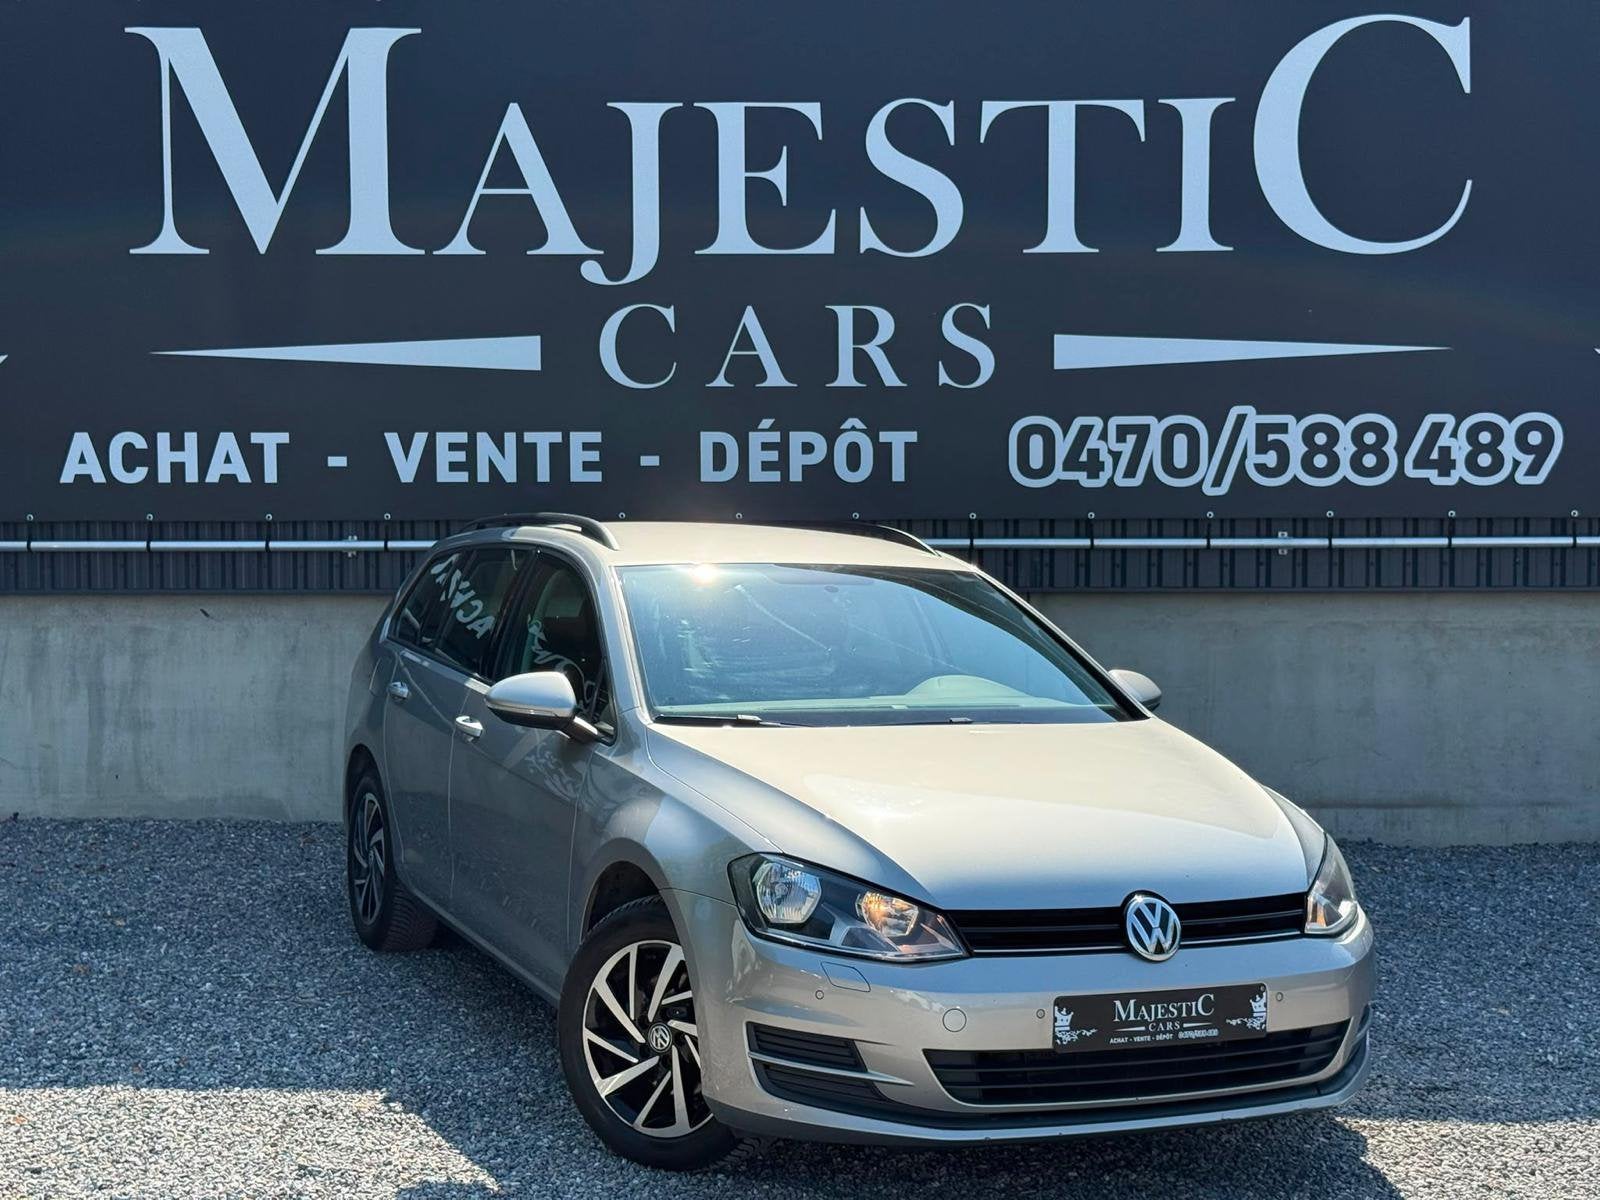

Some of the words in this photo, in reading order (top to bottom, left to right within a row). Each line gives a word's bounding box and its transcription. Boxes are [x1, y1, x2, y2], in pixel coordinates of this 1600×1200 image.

[125, 14, 1472, 285] MAJESTIC
[600, 303, 995, 388] CARS
[60, 432, 290, 483] ACHAT
[384, 432, 602, 483] VENTE
[700, 418, 917, 482] DÉPÔT
[1009, 406, 1398, 496] 0470/588
[1404, 412, 1563, 485] 489
[1113, 993, 1215, 1022] MAJESTIC
[1148, 1021, 1180, 1031] CARS
